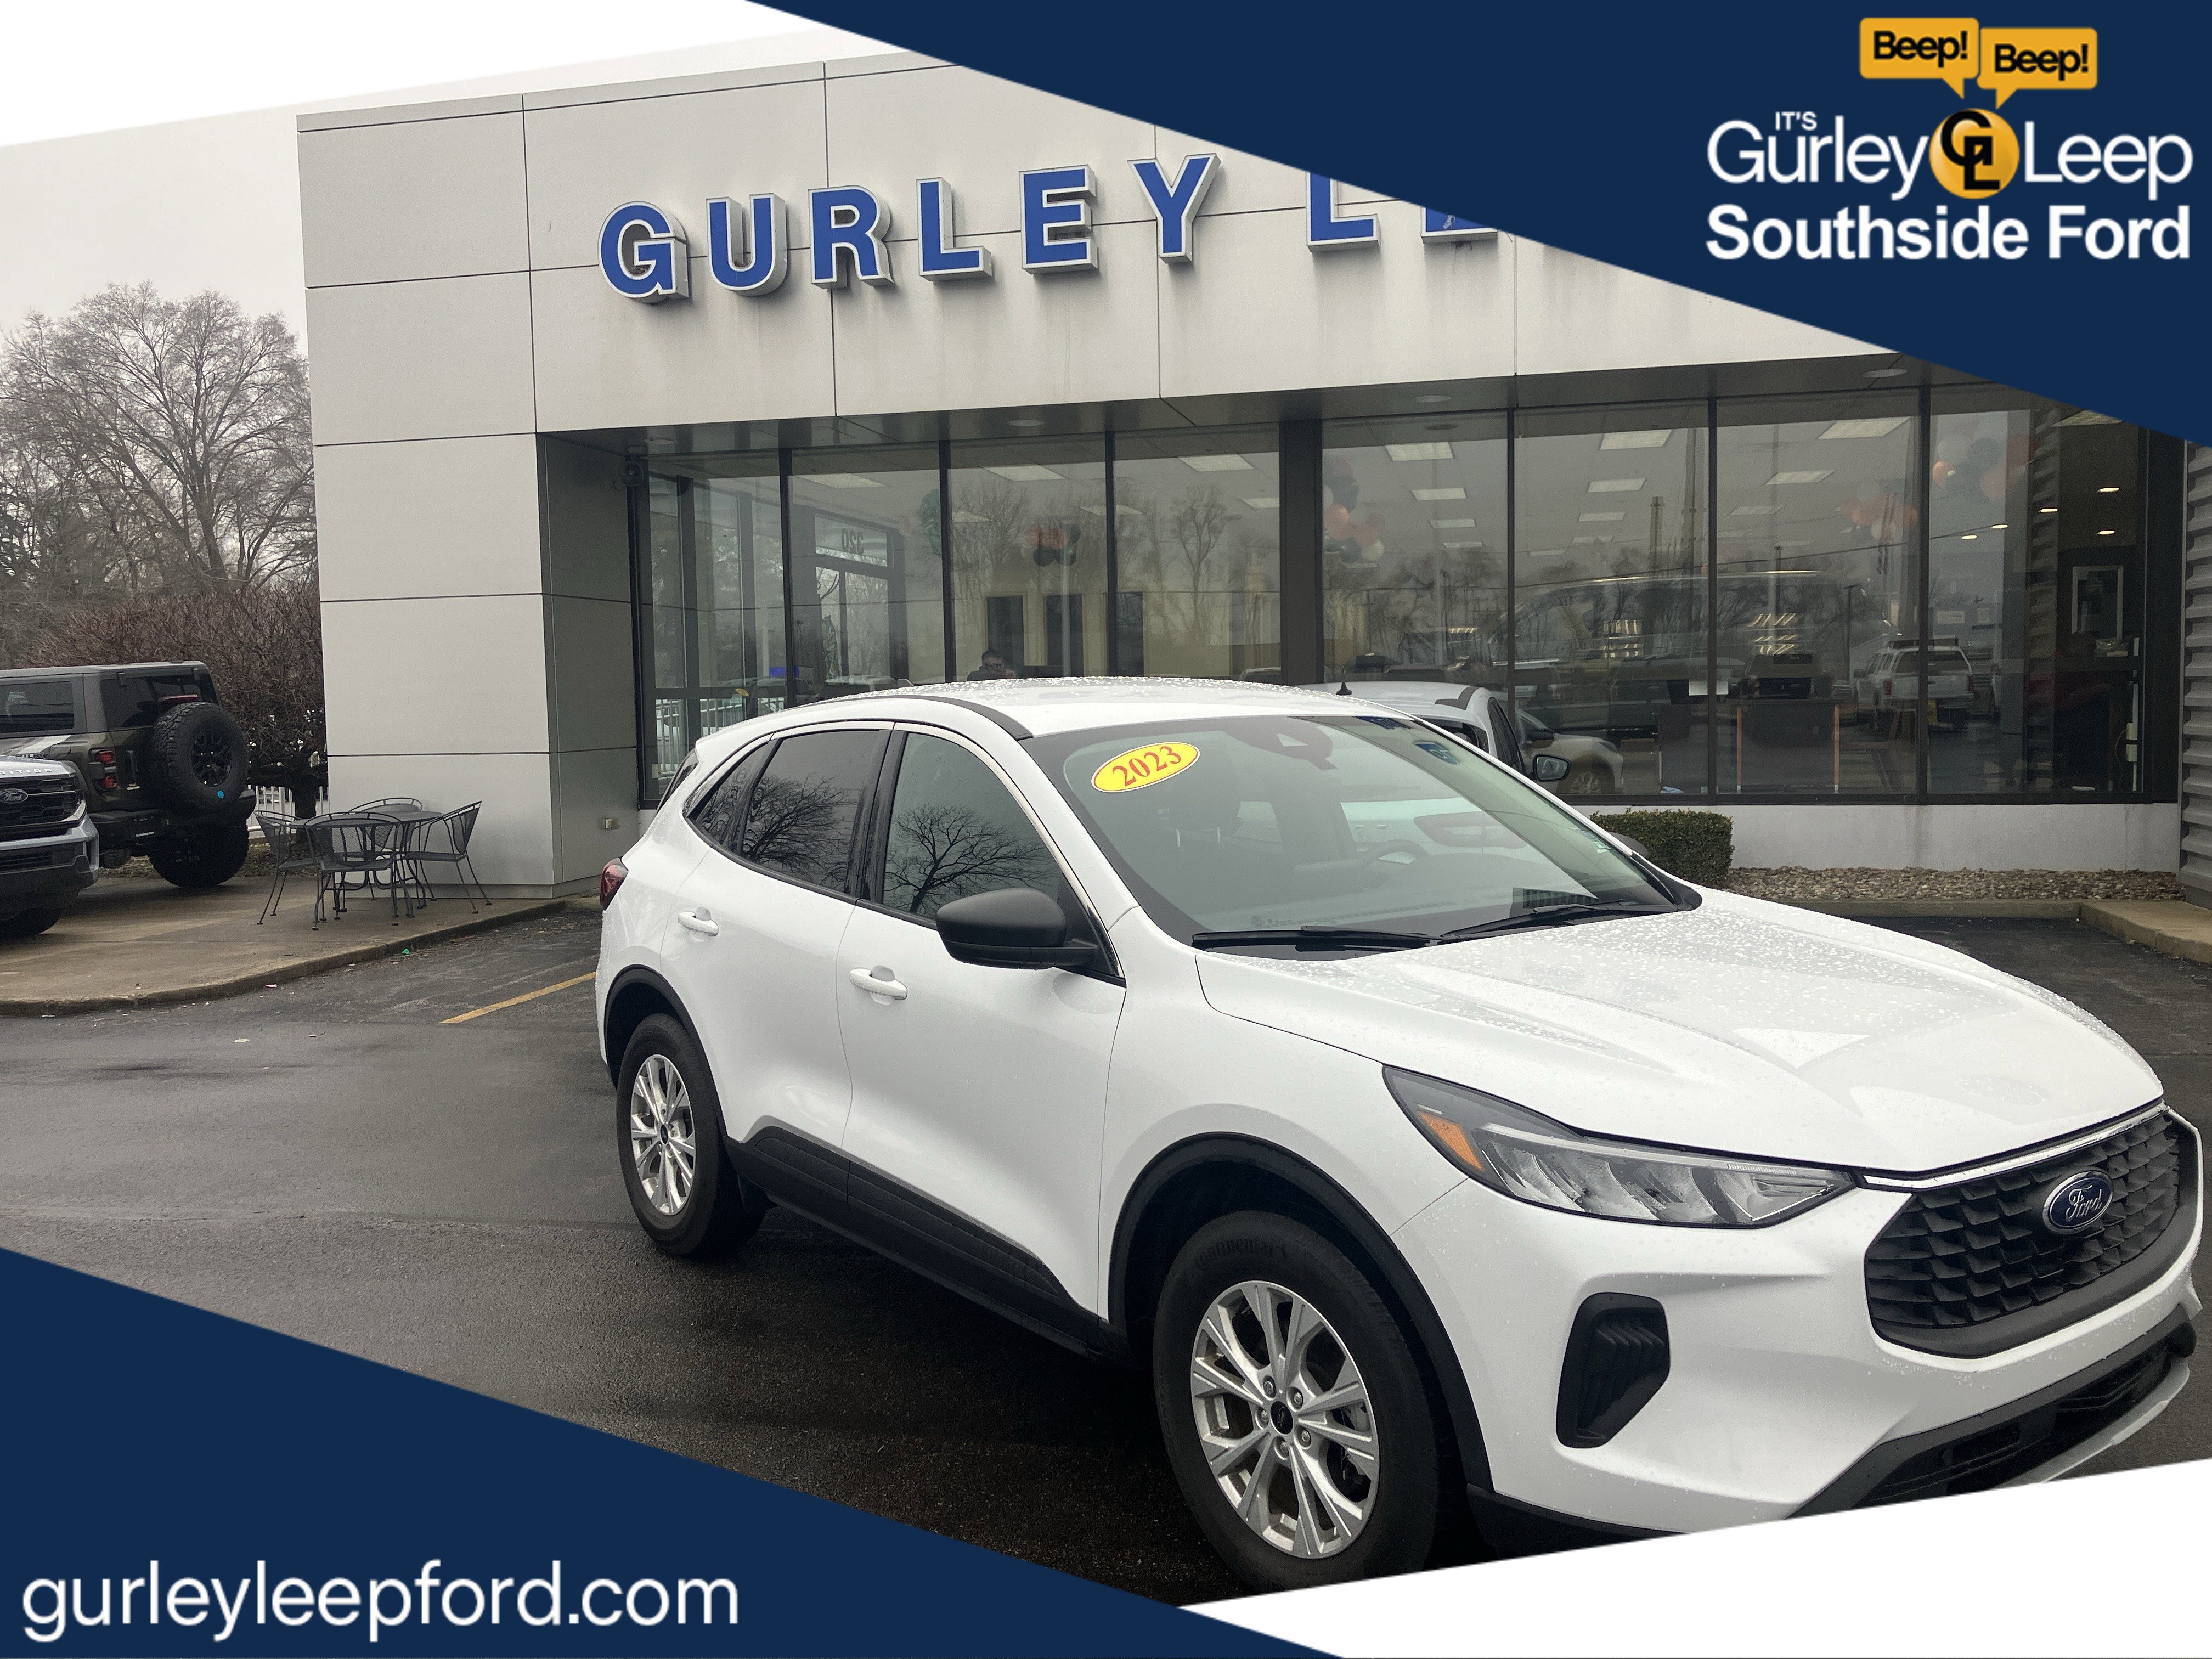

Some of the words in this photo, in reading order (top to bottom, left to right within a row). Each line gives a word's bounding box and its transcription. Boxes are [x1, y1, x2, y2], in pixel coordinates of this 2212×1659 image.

[598, 153, 1221, 302] GURLEY
[1112, 746, 1181, 787] 2023
[2065, 1184, 2103, 1222] Ford
